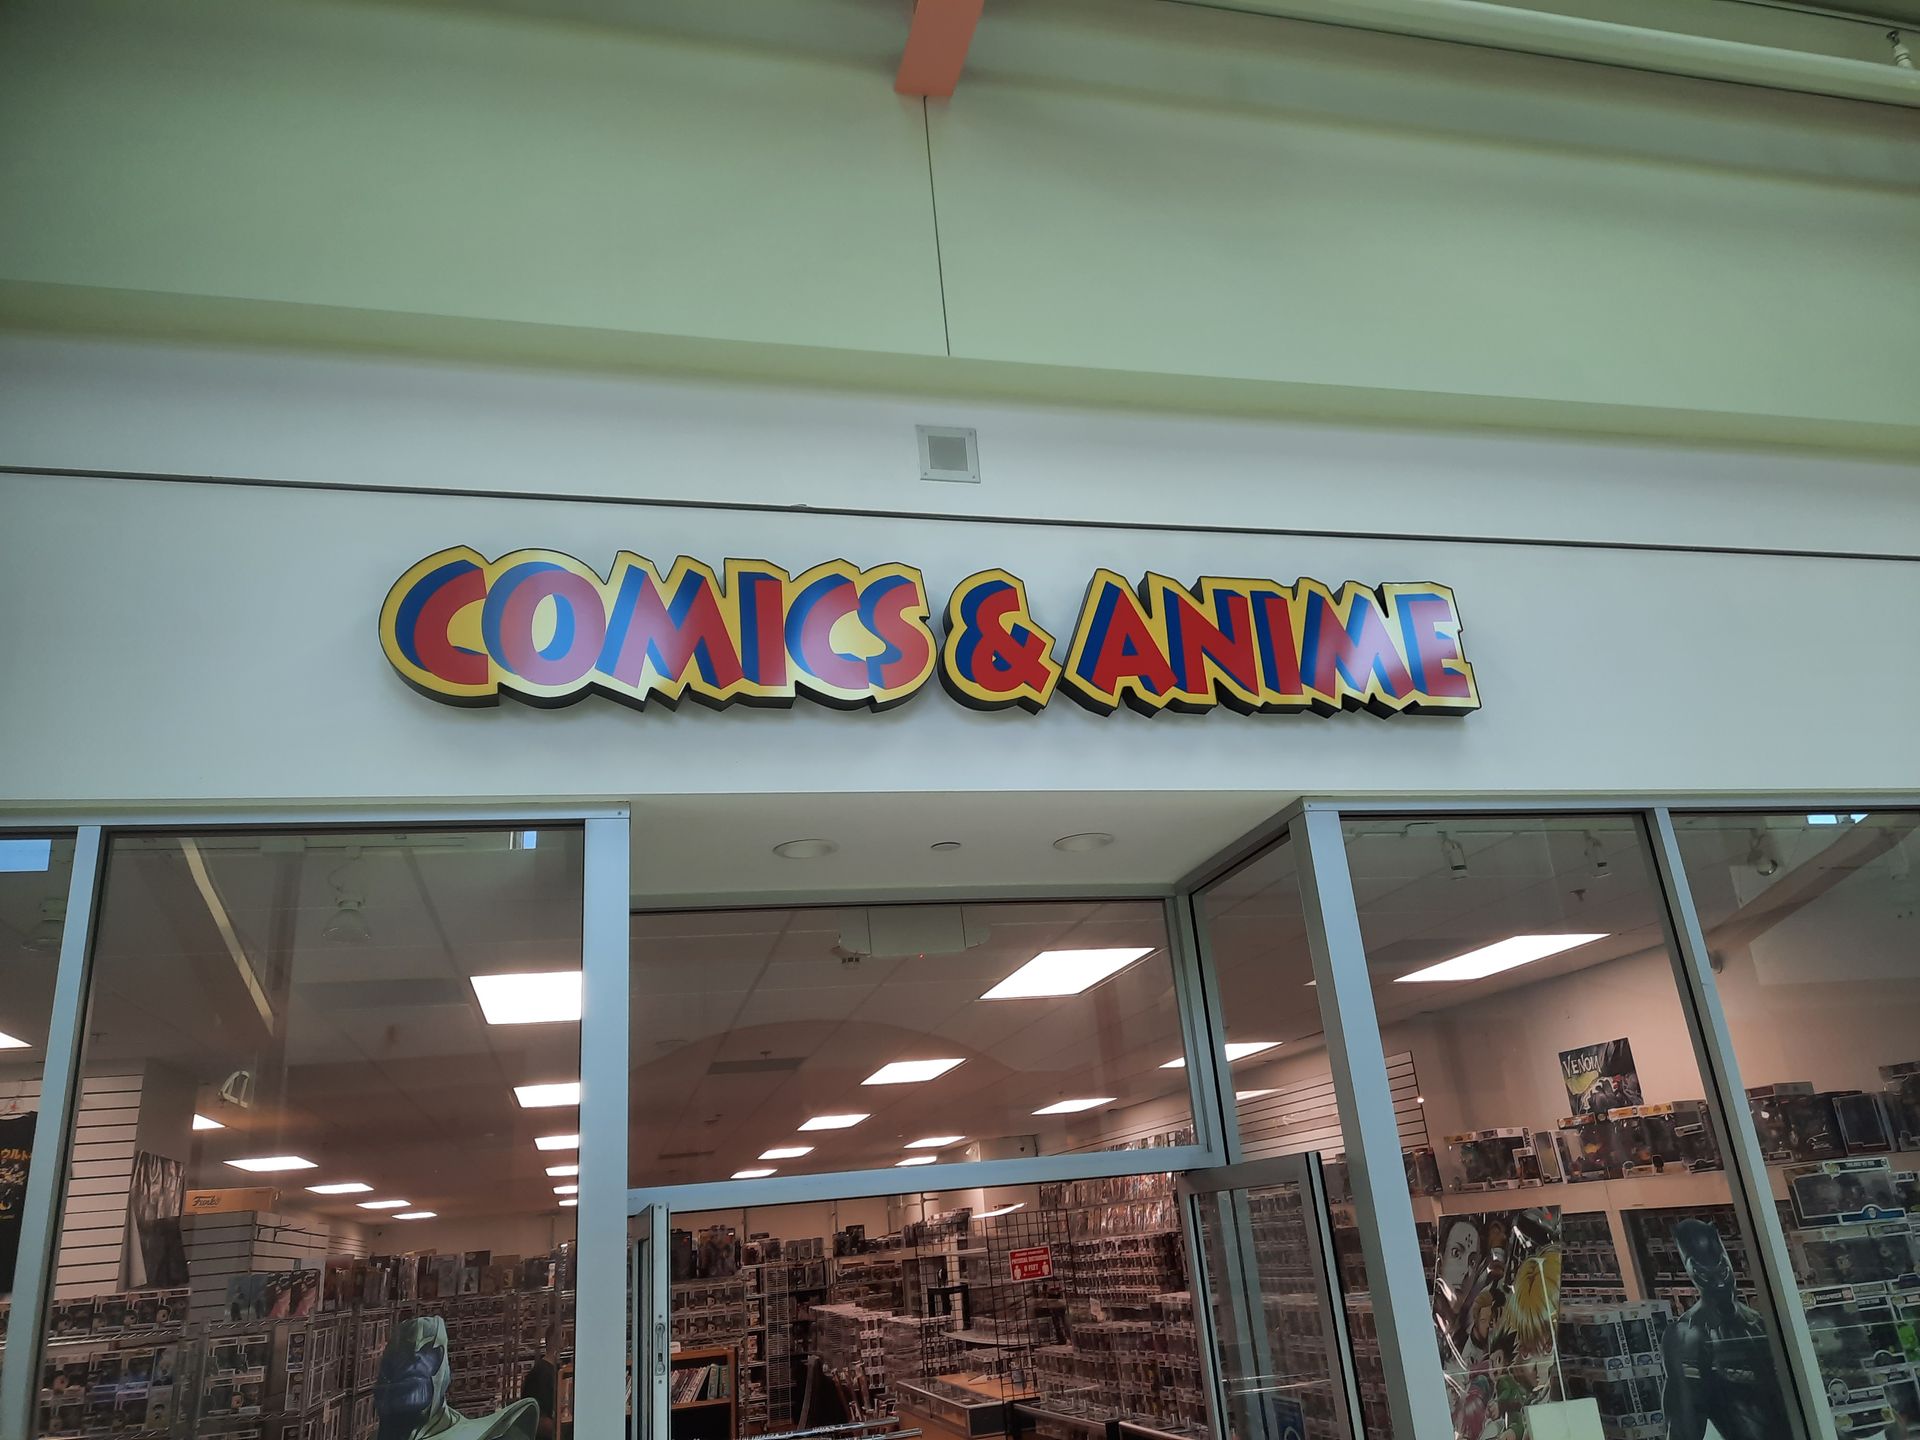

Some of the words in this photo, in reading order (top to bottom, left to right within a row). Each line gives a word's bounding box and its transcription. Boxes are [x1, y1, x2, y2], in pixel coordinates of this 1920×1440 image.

[388, 553, 932, 694] COMICS
[948, 574, 1053, 698] &
[1073, 576, 1474, 700] ANIME
[1562, 1055, 1602, 1078] VENOM
[0, 1149, 31, 1160] ウルト
